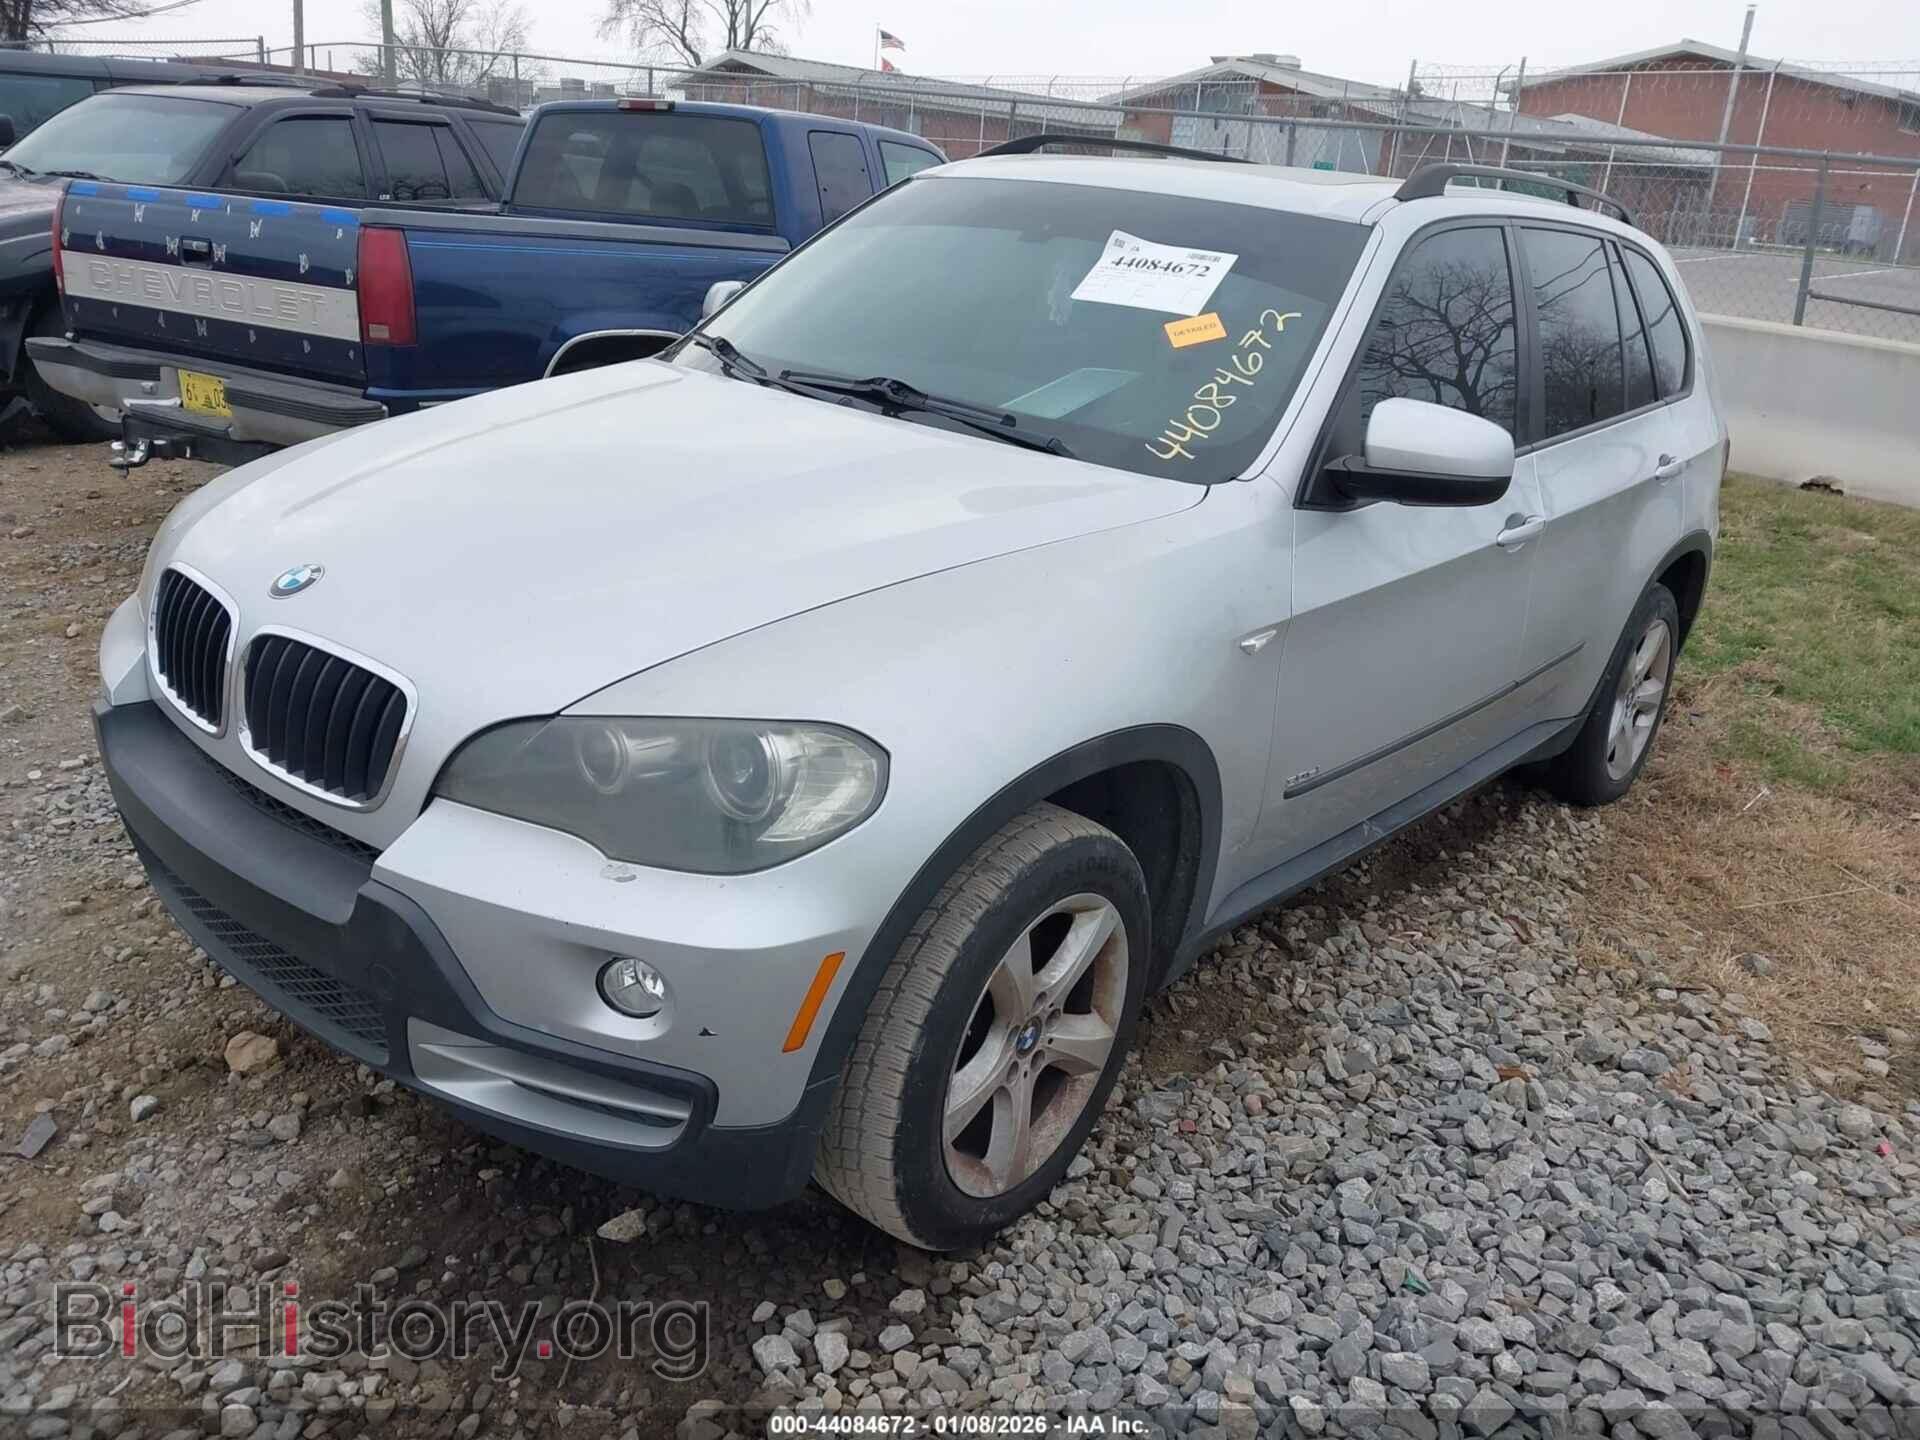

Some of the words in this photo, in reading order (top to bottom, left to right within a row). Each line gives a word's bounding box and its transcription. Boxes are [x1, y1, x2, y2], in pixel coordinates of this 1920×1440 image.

[87, 259, 326, 326] CHEVROLET
[1111, 255, 1211, 278] 44084672
[1145, 308, 1302, 460] 44084672
